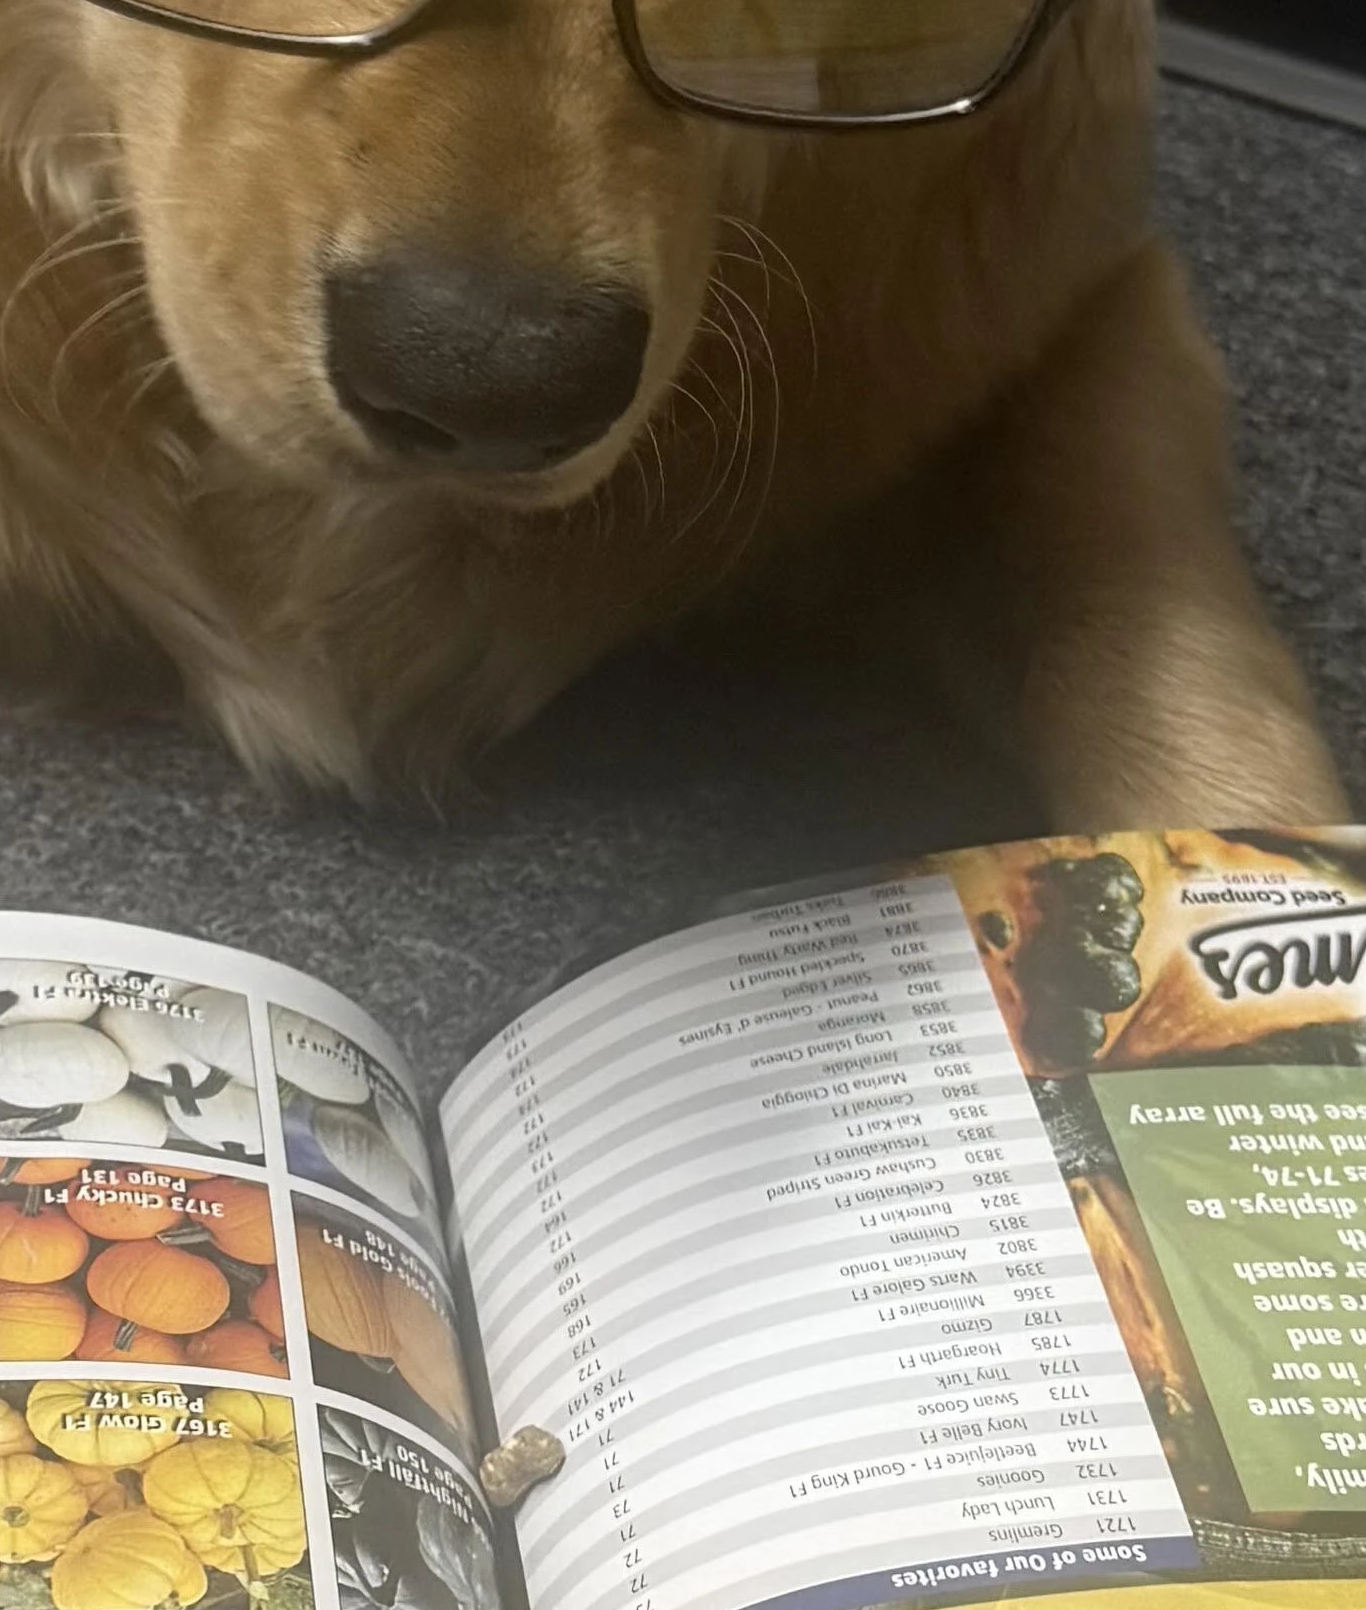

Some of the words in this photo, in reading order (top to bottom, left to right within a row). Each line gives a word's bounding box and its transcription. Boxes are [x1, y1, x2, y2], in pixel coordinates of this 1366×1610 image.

[1179, 887, 1287, 907] Company
[1291, 891, 1347, 907] Seed
[82, 1169, 119, 1185] 131
[128, 1171, 186, 1193] Page
[972, 1170, 1012, 1187] 3826
[45, 1189, 69, 1203] F1
[76, 1185, 163, 1209] Chucky
[855, 1180, 944, 1202] Celebration
[171, 1197, 224, 1218] 3173
[834, 1195, 852, 1209] F1
[997, 1238, 1037, 1255] 3802
[893, 1248, 966, 1267] American
[839, 1260, 890, 1278] Tondo
[579, 1359, 601, 1382] 172
[977, 1367, 1011, 1381] Tiny
[1039, 1359, 1080, 1376] 1774
[935, 1373, 974, 1389] Turk
[977, 1469, 1045, 1489] Goonies
[1075, 1463, 1117, 1479] 1732
[609, 1475, 625, 1493] 71
[988, 1524, 1063, 1543] Gremlins
[1096, 1517, 1136, 1533] 1721
[1053, 1551, 1076, 1571] of
[1083, 1545, 1147, 1562] Some
[1005, 1555, 1046, 1571] Our
[891, 1560, 999, 1587] favorites
[631, 1573, 648, 1594] 72
